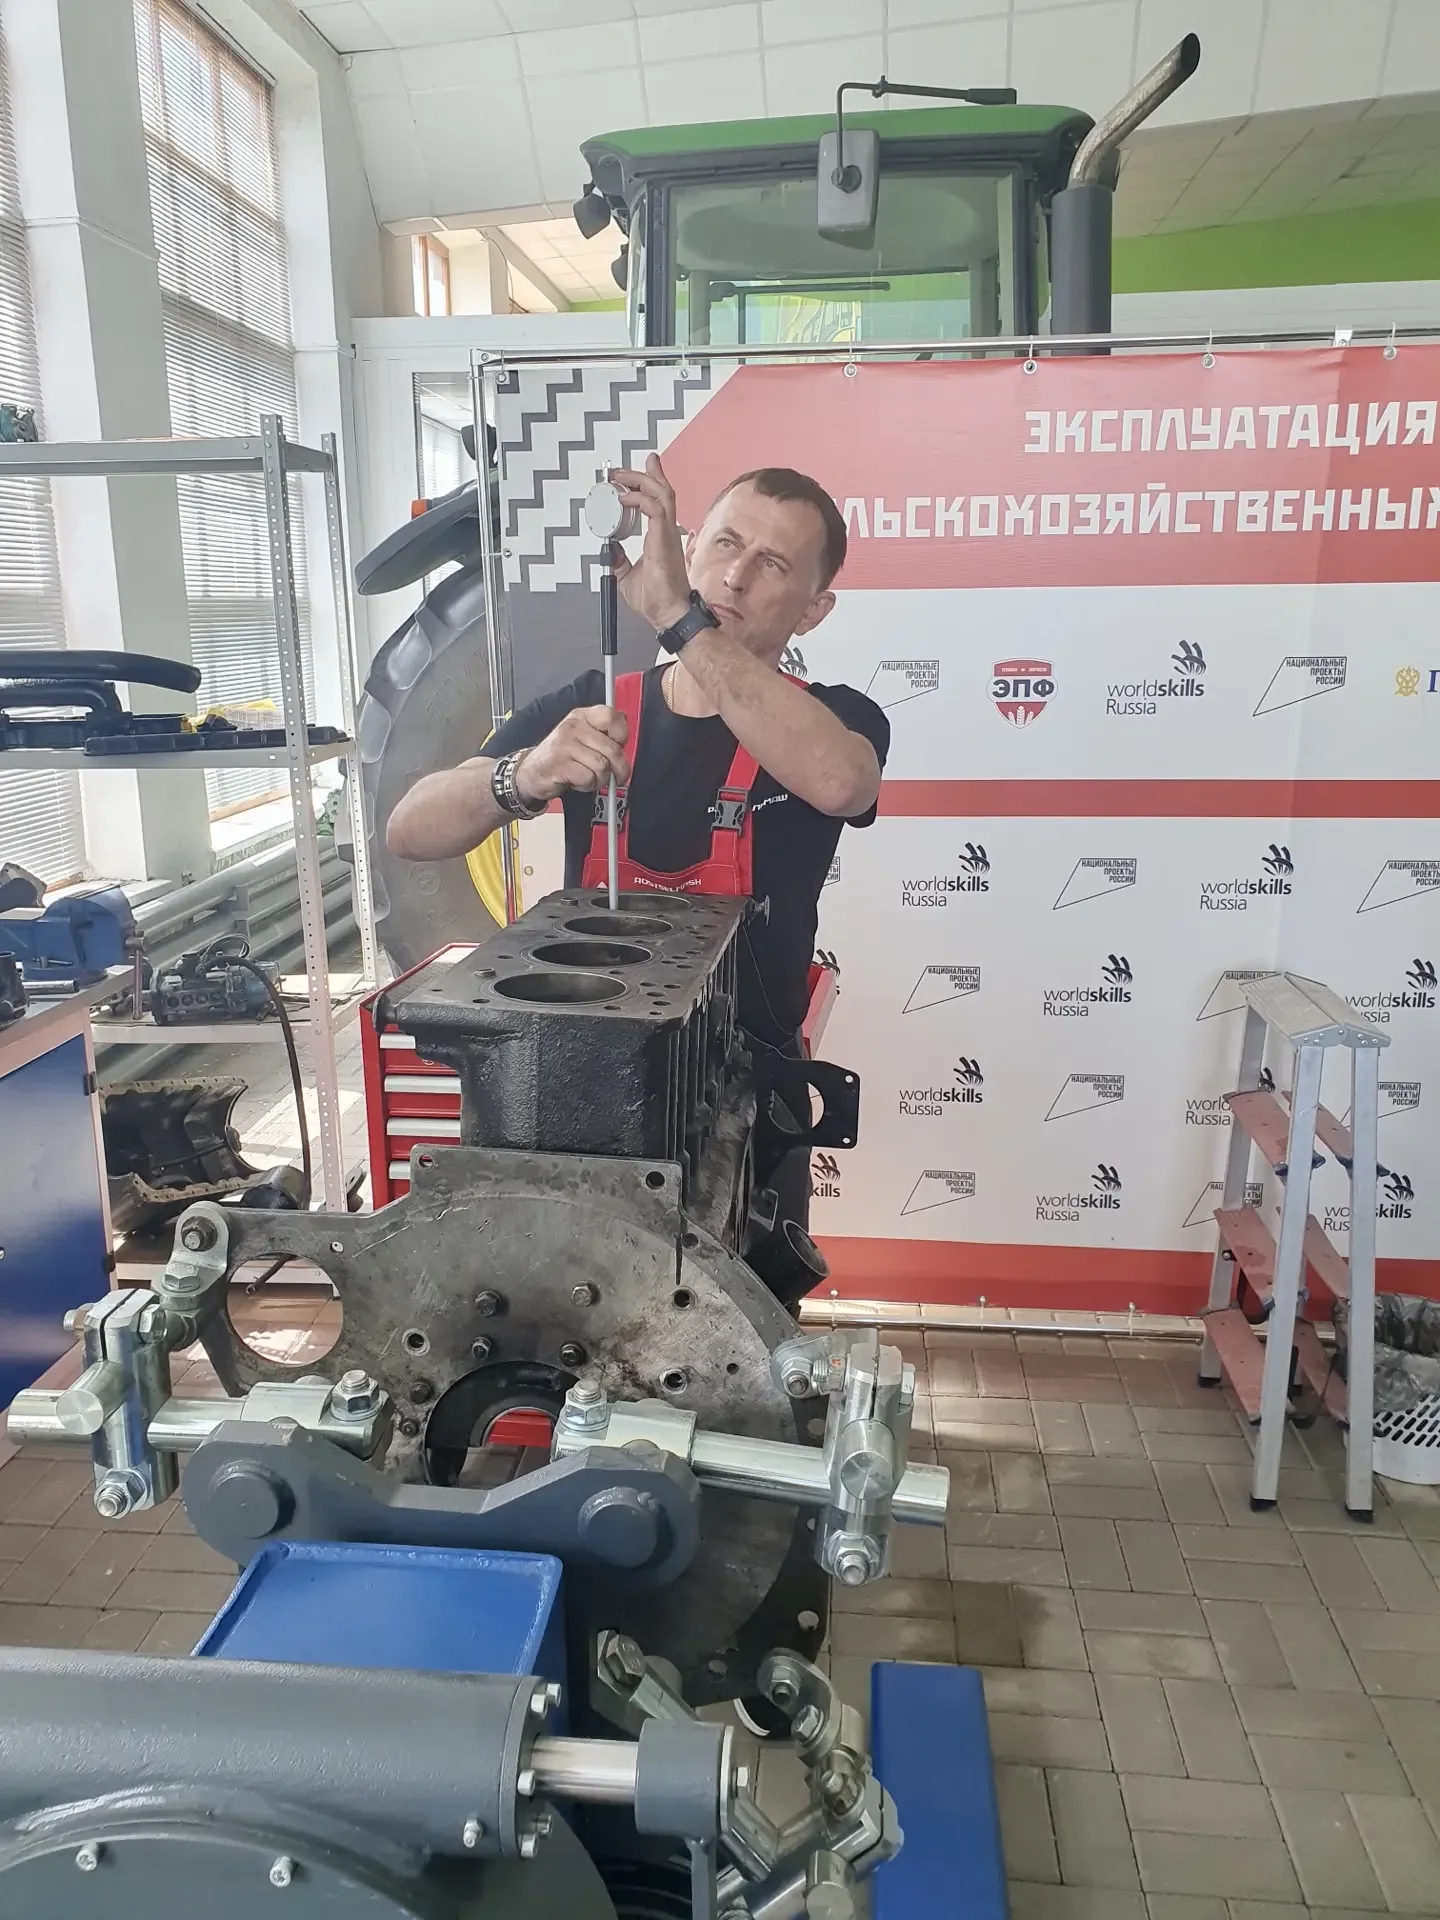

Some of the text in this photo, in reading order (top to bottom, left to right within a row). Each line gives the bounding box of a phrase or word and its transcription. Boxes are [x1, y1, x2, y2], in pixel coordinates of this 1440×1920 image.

[1025, 401, 1438, 454] ЭКСПЛУАТАЦИЯ
[832, 483, 1440, 537] ЛЬСКОХОЗЯЙСТВЕННЫ
[882, 662, 937, 671] НАЦИОНАЛЬНЫЕ
[1286, 659, 1345, 668] НАЦИОНАЛЬНЫЕ
[905, 671, 937, 679] ПРОЕКТЫ
[1310, 668, 1344, 676] ПРОЕКТЫ
[910, 679, 937, 688] РОССИИ
[1107, 678, 1205, 697] worldskills
[1315, 676, 1343, 685] РОССИИ
[992, 679, 1055, 698] ЭПФ
[1106, 698, 1157, 715] Russia
[1082, 859, 1135, 868] НАЦИОНАЛЬНЫЕ
[1389, 862, 1440, 871] НАЦИОНАЛЬНЫ
[902, 876, 990, 892] worldskills
[1109, 875, 1135, 883] РОССИИ
[1200, 878, 1292, 895] worldskills
[902, 892, 947, 907] Russia
[1200, 895, 1247, 910] Russia
[928, 967, 979, 975] НАЦИОНАЛЬНЫЕ
[949, 975, 979, 983] ПРОЕКТЫ
[954, 982, 978, 990] РОССИИ
[1044, 987, 1132, 1003] worldskills
[1345, 992, 1435, 1008] worldskills
[1043, 1002, 1089, 1017] Russia
[1072, 1075, 1123, 1084] НАЦИОНАЛЬНЫЕ
[899, 1087, 983, 1104] worldskills
[1098, 1091, 1122, 1099] РОССИИ
[1392, 1098, 1418, 1106] РОССИИ
[899, 1101, 943, 1116] Russia
[1185, 1111, 1231, 1126] Russia
[945, 1179, 974, 1187] ПРОЕКТЫ
[1036, 1193, 1121, 1210] worldskills
[1035, 1208, 1080, 1222] Russia
